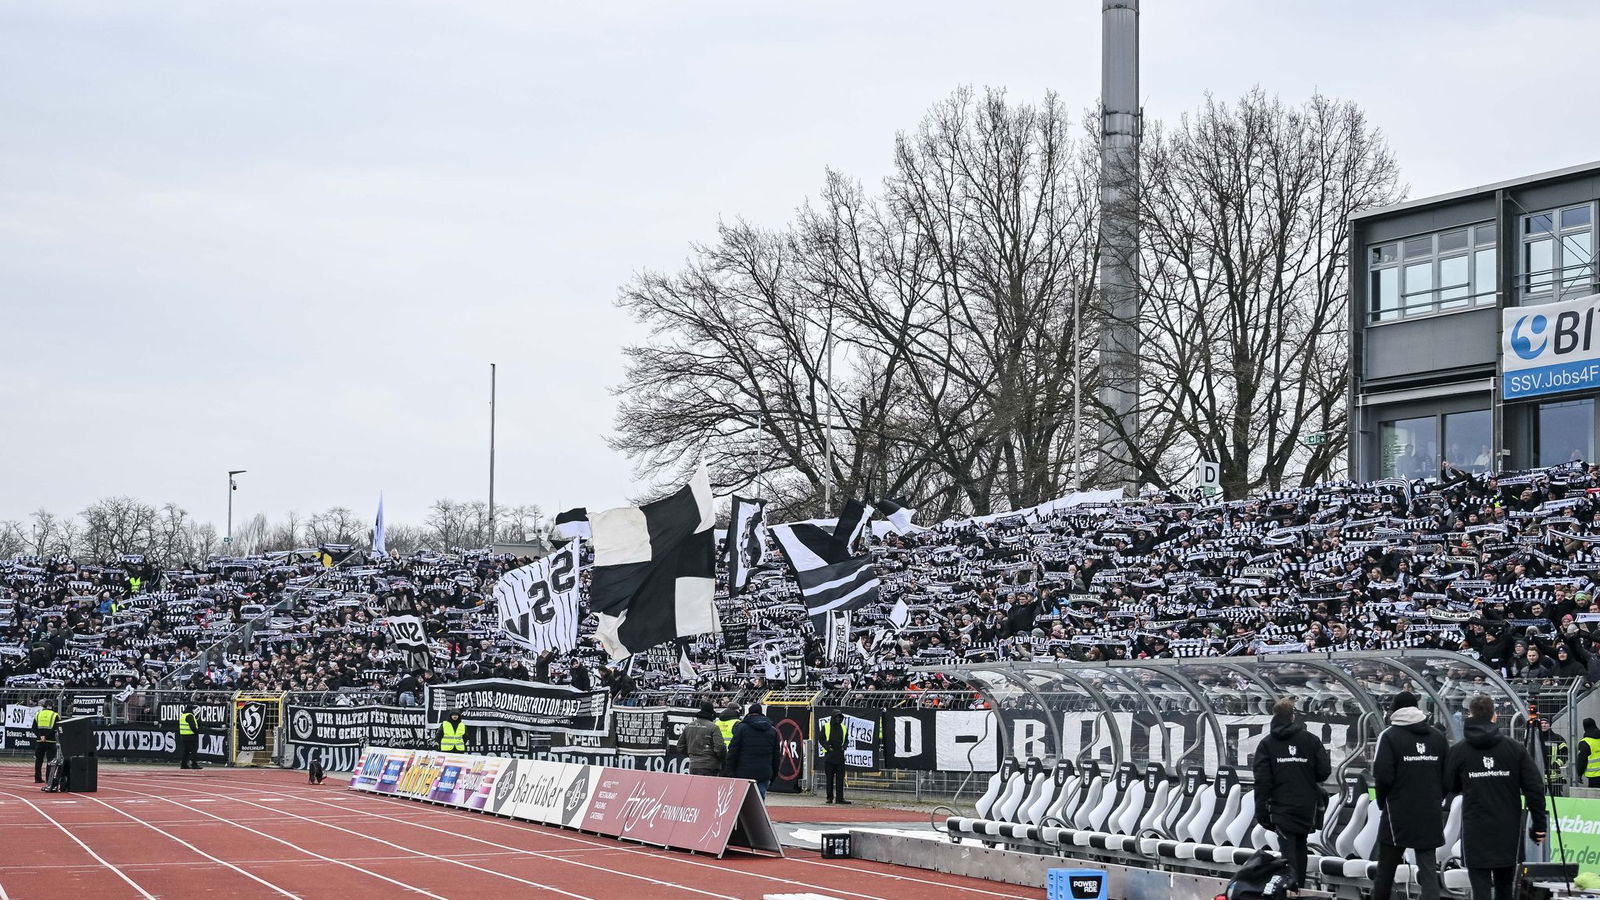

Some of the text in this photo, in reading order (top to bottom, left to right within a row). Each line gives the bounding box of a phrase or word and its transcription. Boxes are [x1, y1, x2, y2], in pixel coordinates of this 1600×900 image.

[1554, 307, 1600, 356] BI
[1205, 466, 1215, 482] D
[201, 705, 226, 722] CREW
[315, 711, 425, 726] WIR HALTEN FEST ZUSAMM
[317, 726, 336, 739] UND
[338, 726, 369, 740] GEHEN
[372, 727, 413, 739] UNSEREN
[1468, 770, 1510, 778] HanseMerkur
[660, 804, 700, 823] FINNINGEN
